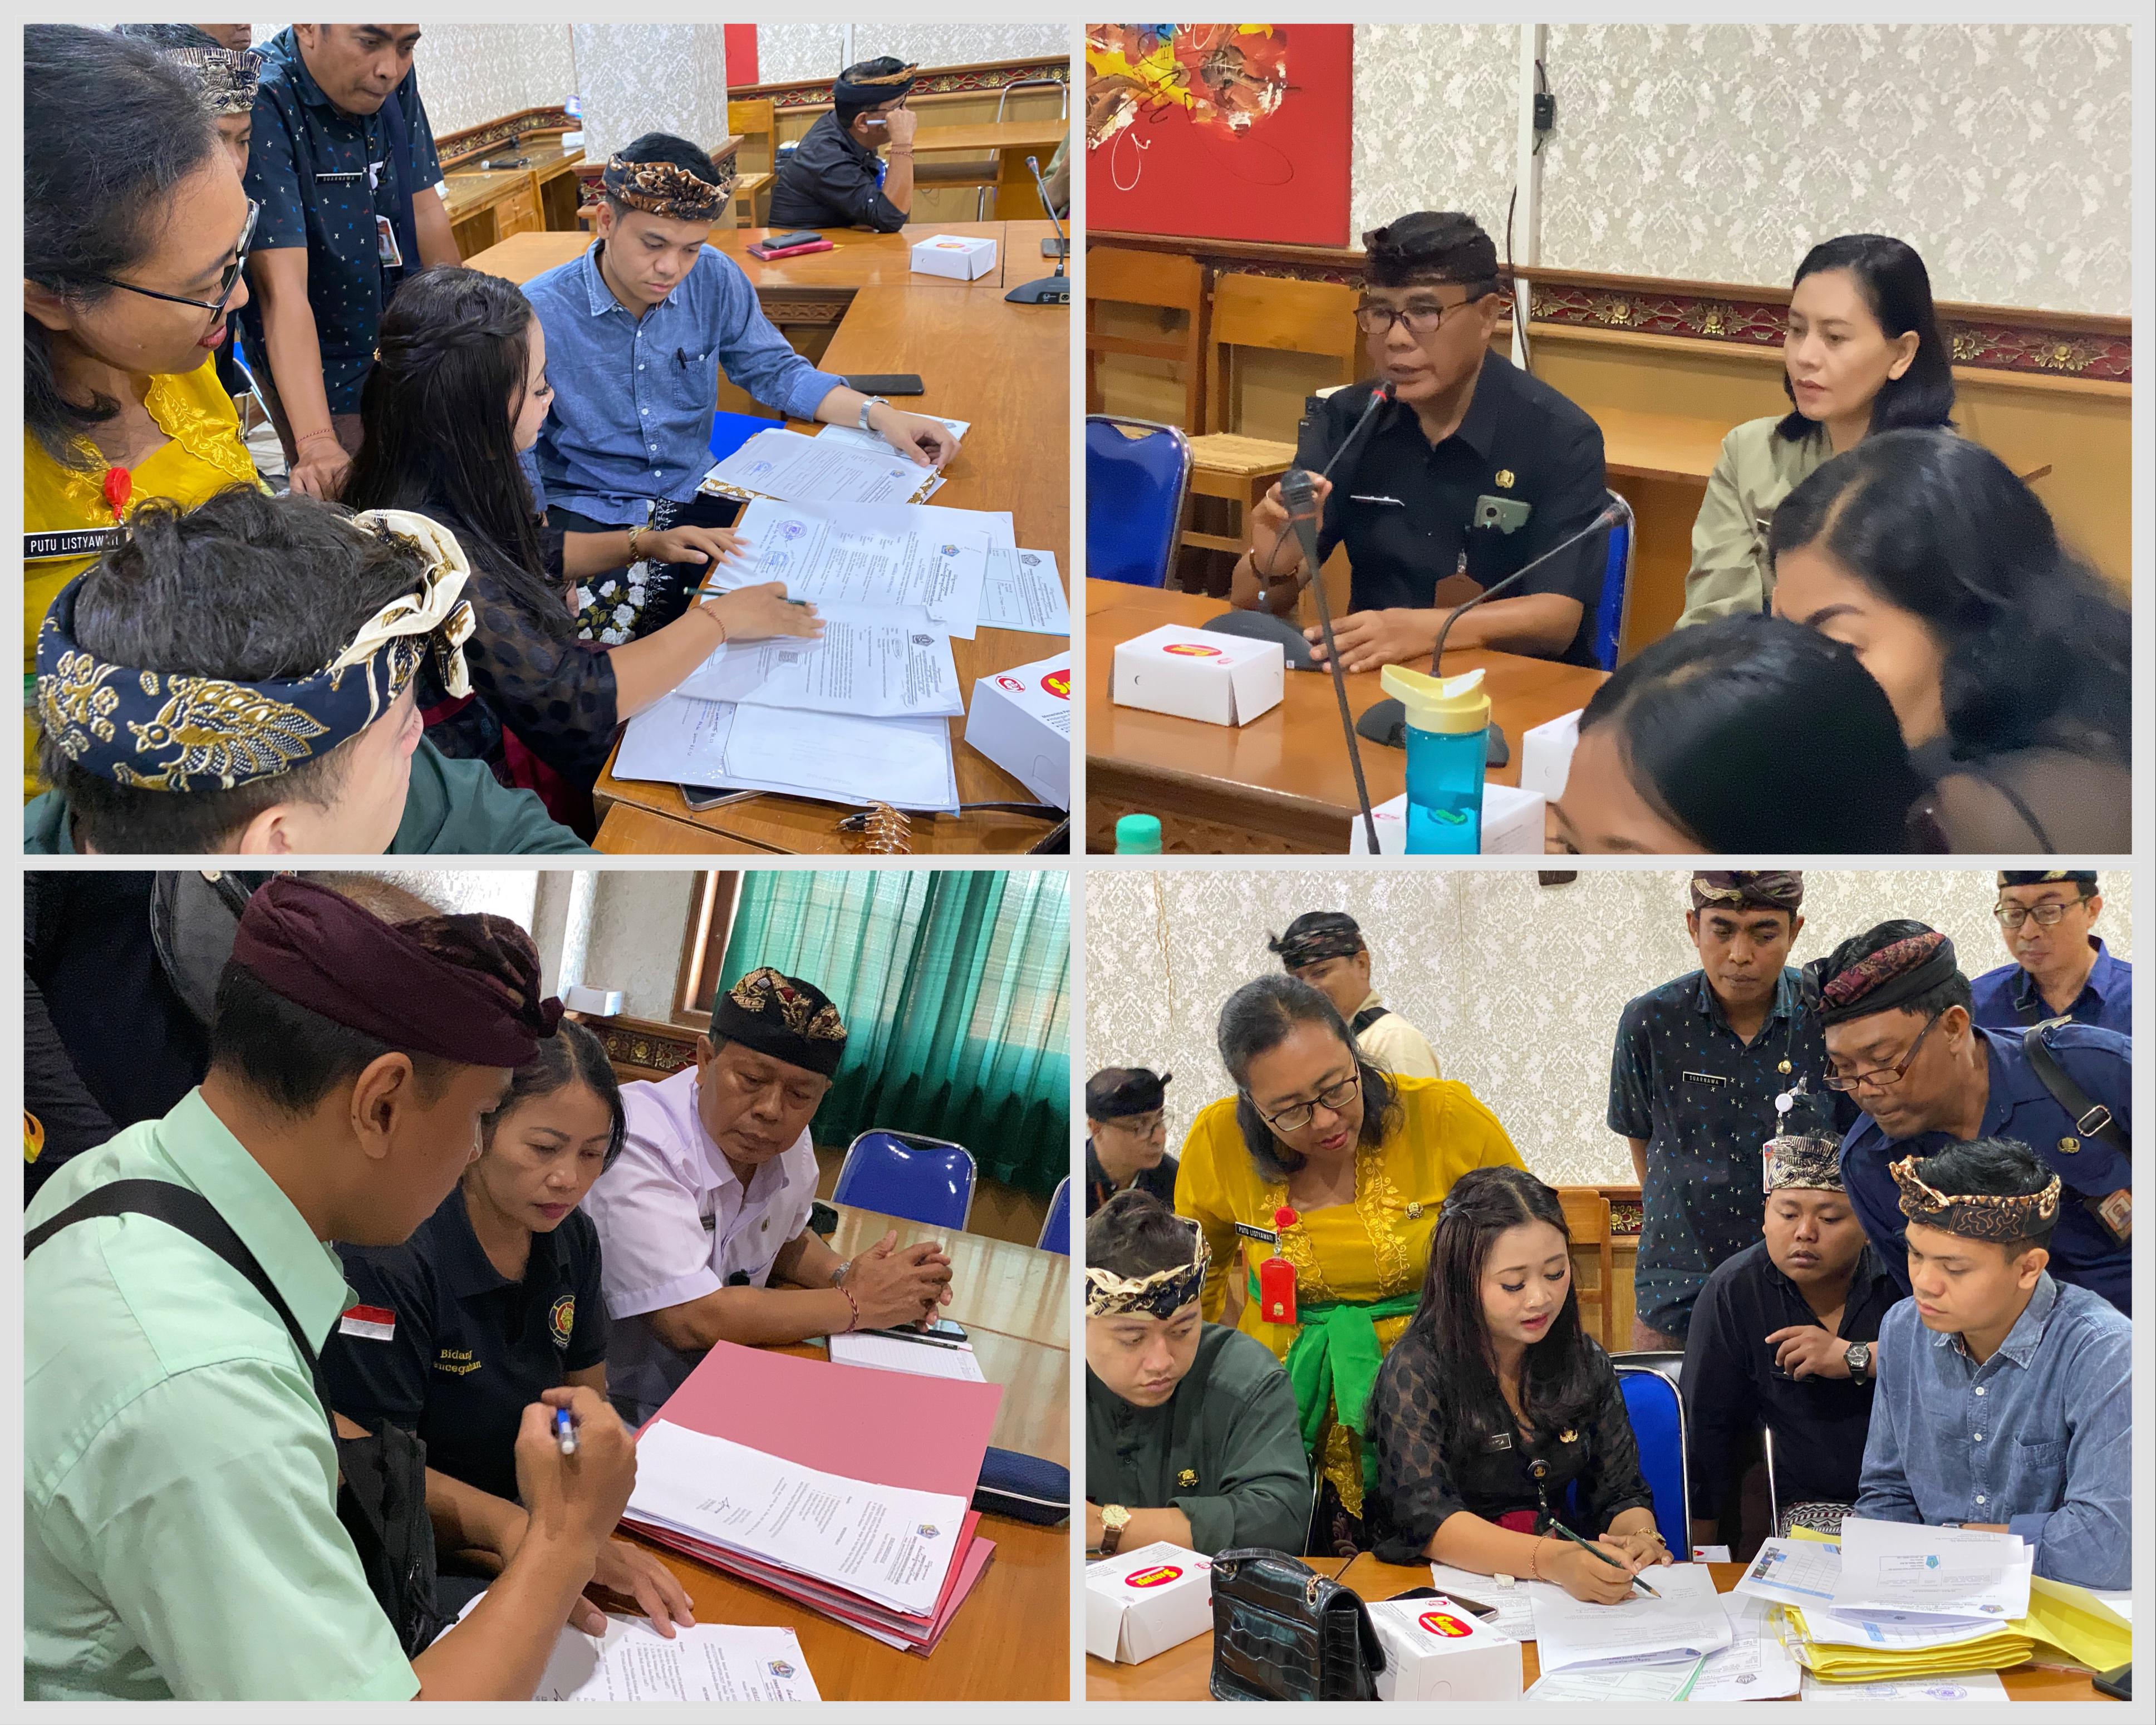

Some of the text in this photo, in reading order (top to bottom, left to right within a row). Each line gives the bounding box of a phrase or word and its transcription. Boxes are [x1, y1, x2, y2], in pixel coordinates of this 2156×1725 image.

[30, 539, 57, 552] PUTU
[1690, 1075, 1718, 1085] SUARNAWA
[1239, 1226, 1273, 1241] PUTU LISTYAWATI
